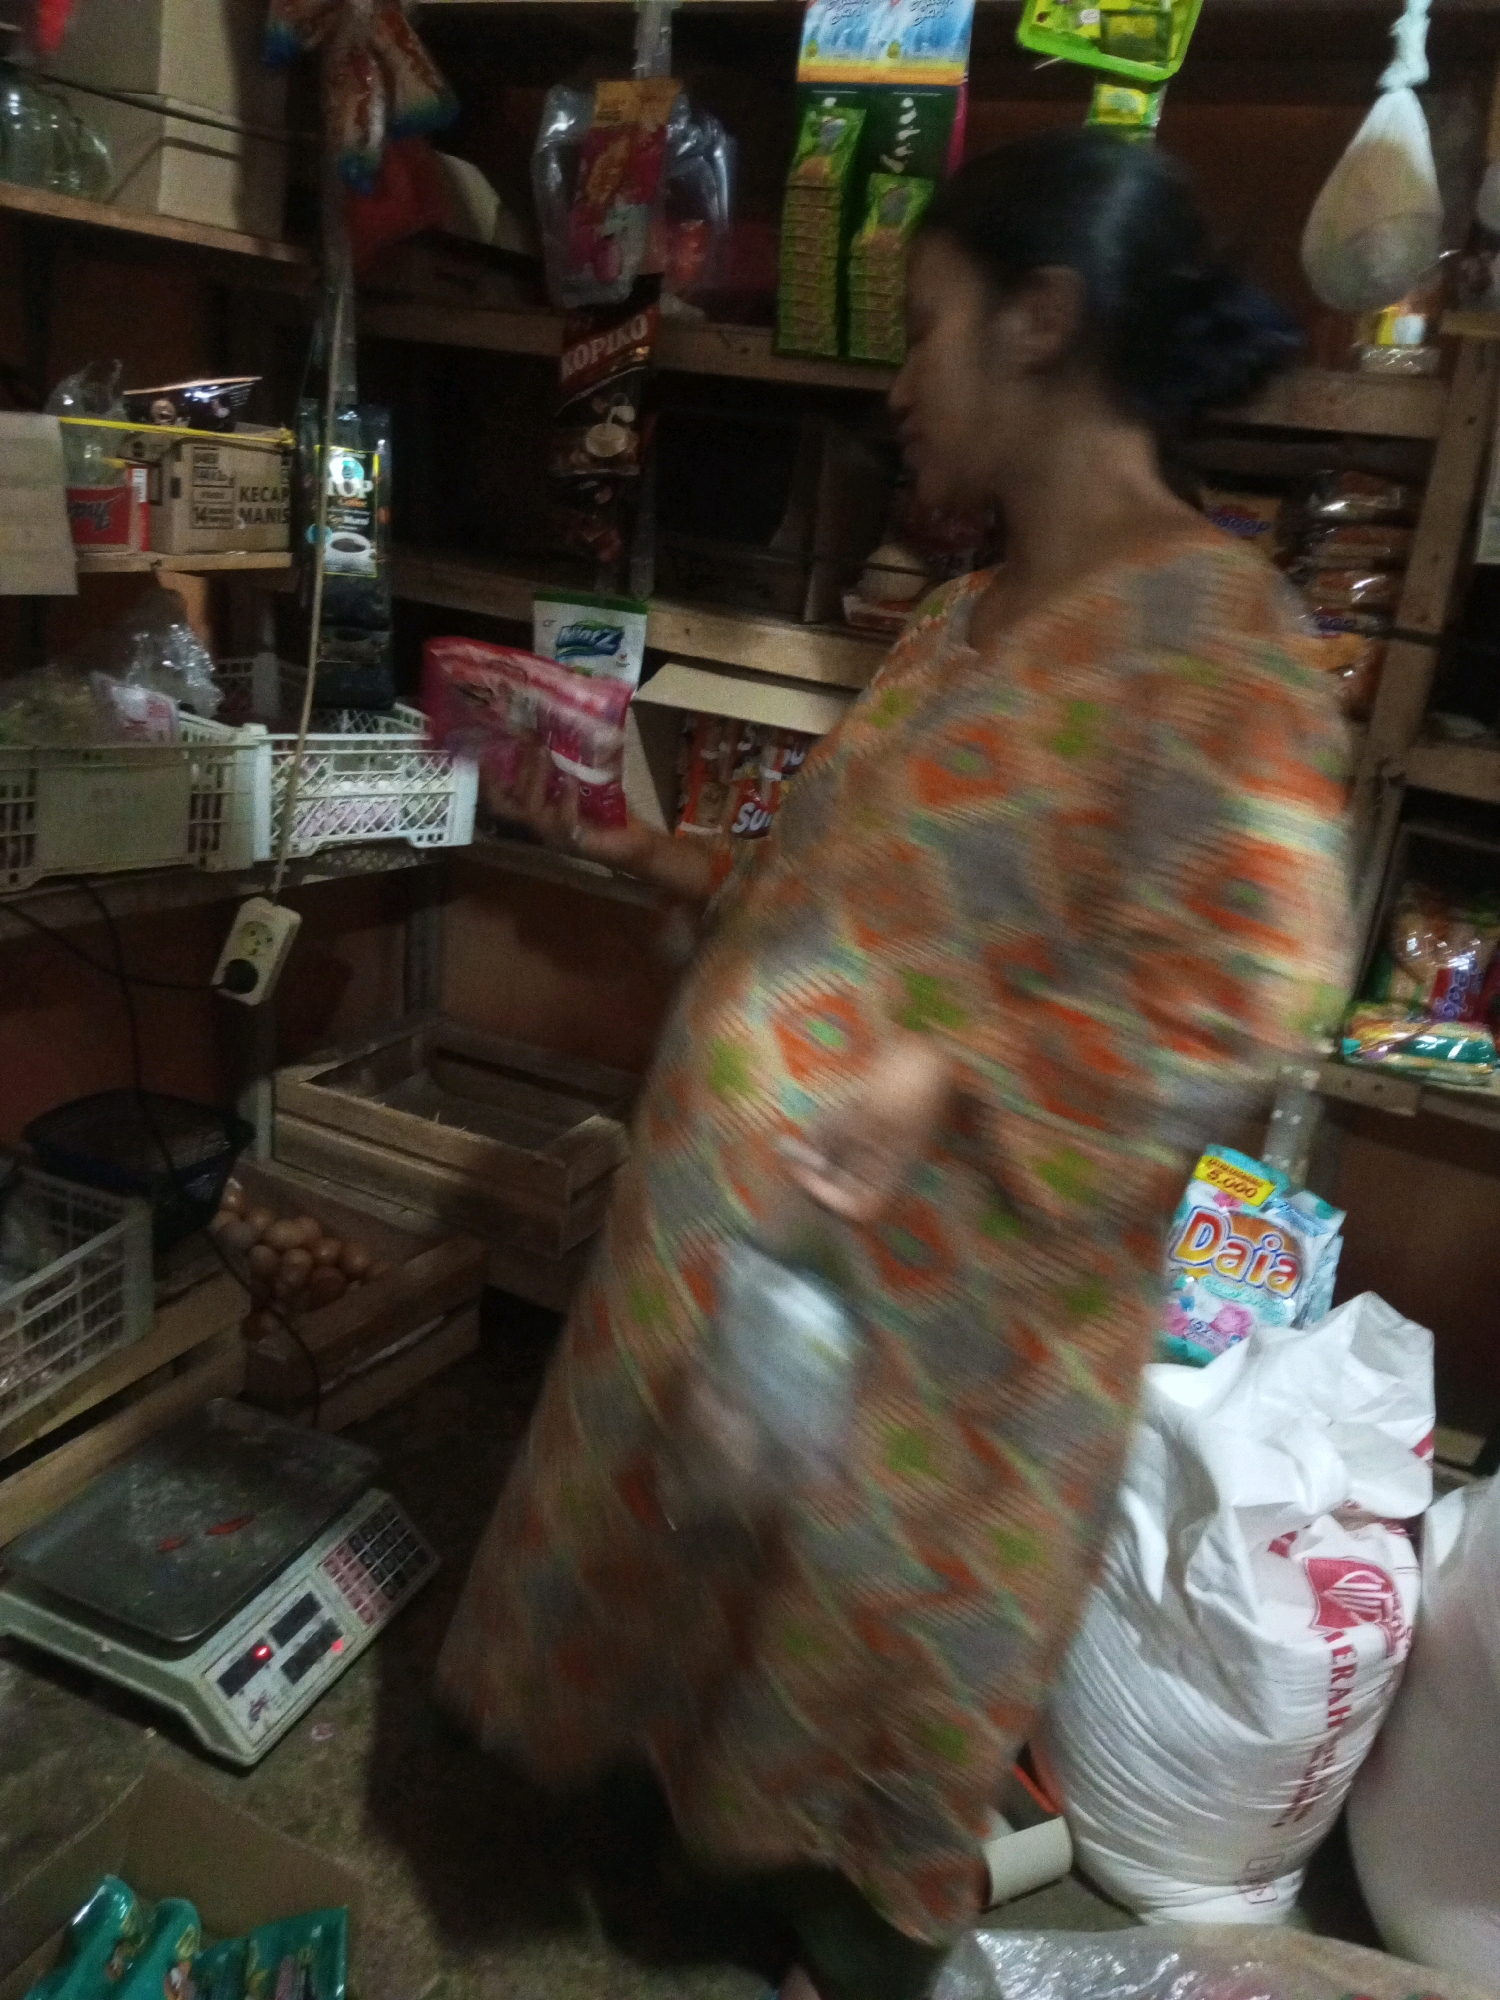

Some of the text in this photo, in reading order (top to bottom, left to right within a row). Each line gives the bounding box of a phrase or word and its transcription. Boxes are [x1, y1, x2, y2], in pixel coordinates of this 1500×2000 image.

[561, 314, 648, 382] KOPIKO
[239, 508, 290, 524] MANIS
[240, 486, 290, 503] KECAP
[1207, 1168, 1258, 1198] 5.000
[1171, 1208, 1300, 1297] Daia
[1324, 1631, 1357, 1729] ERAH
